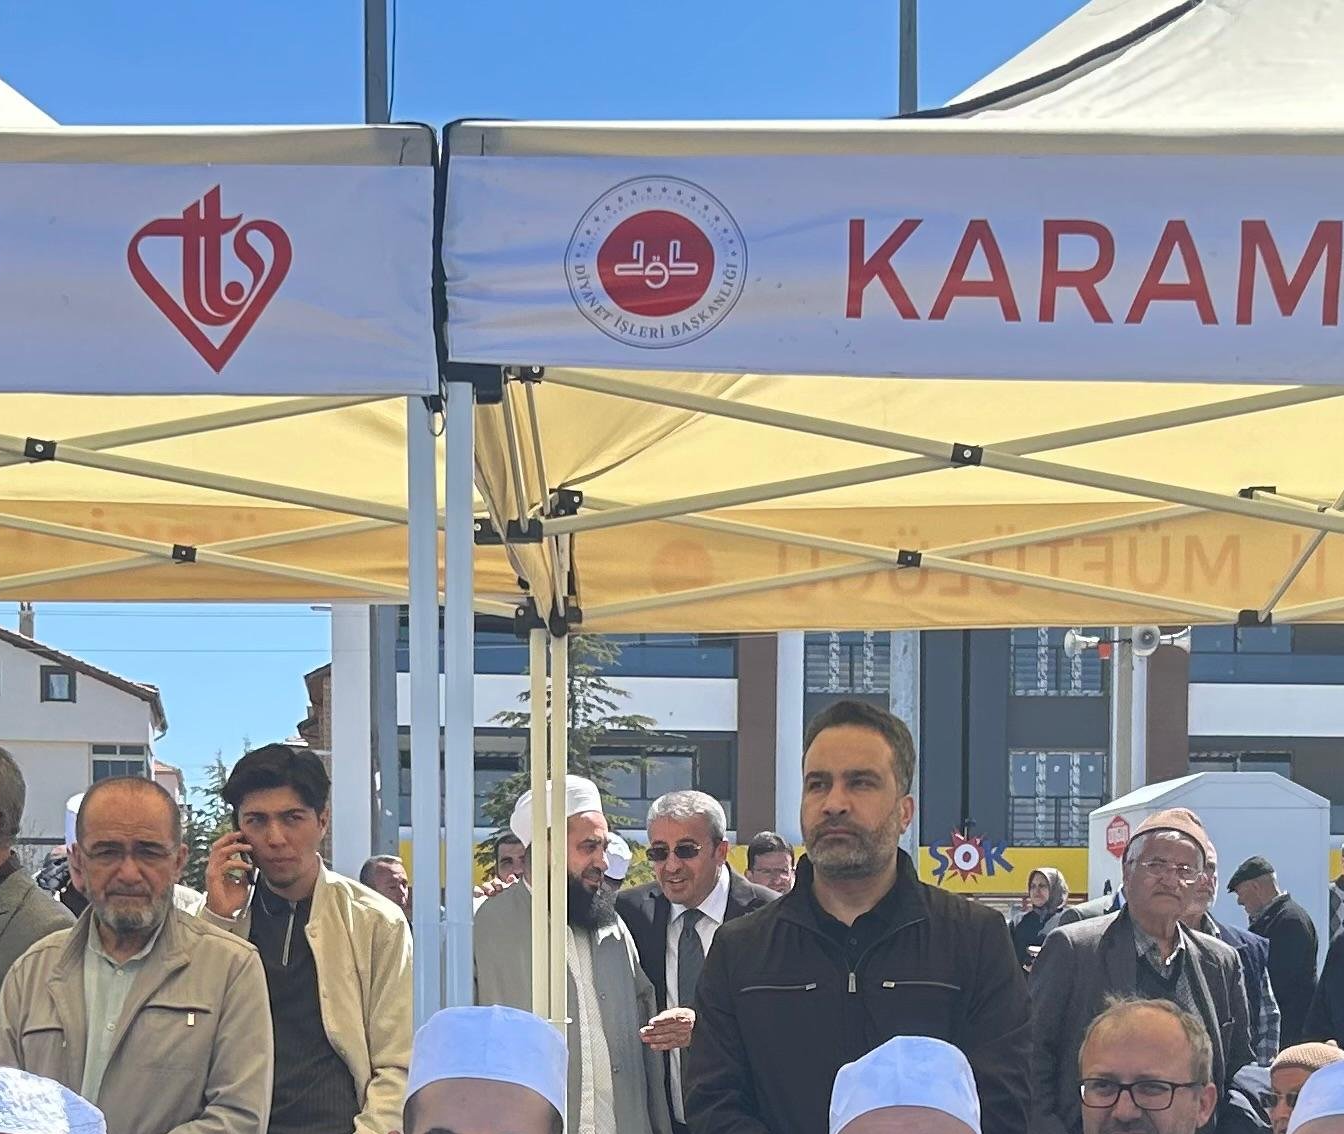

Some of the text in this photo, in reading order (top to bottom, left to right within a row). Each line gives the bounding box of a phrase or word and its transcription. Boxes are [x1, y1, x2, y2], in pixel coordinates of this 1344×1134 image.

[574, 264, 614, 321] DİYANET
[614, 312, 665, 339] İŞLERİ
[670, 263, 738, 338] BAŞKANLIĞI
[929, 838, 1014, 886] ŞOK
